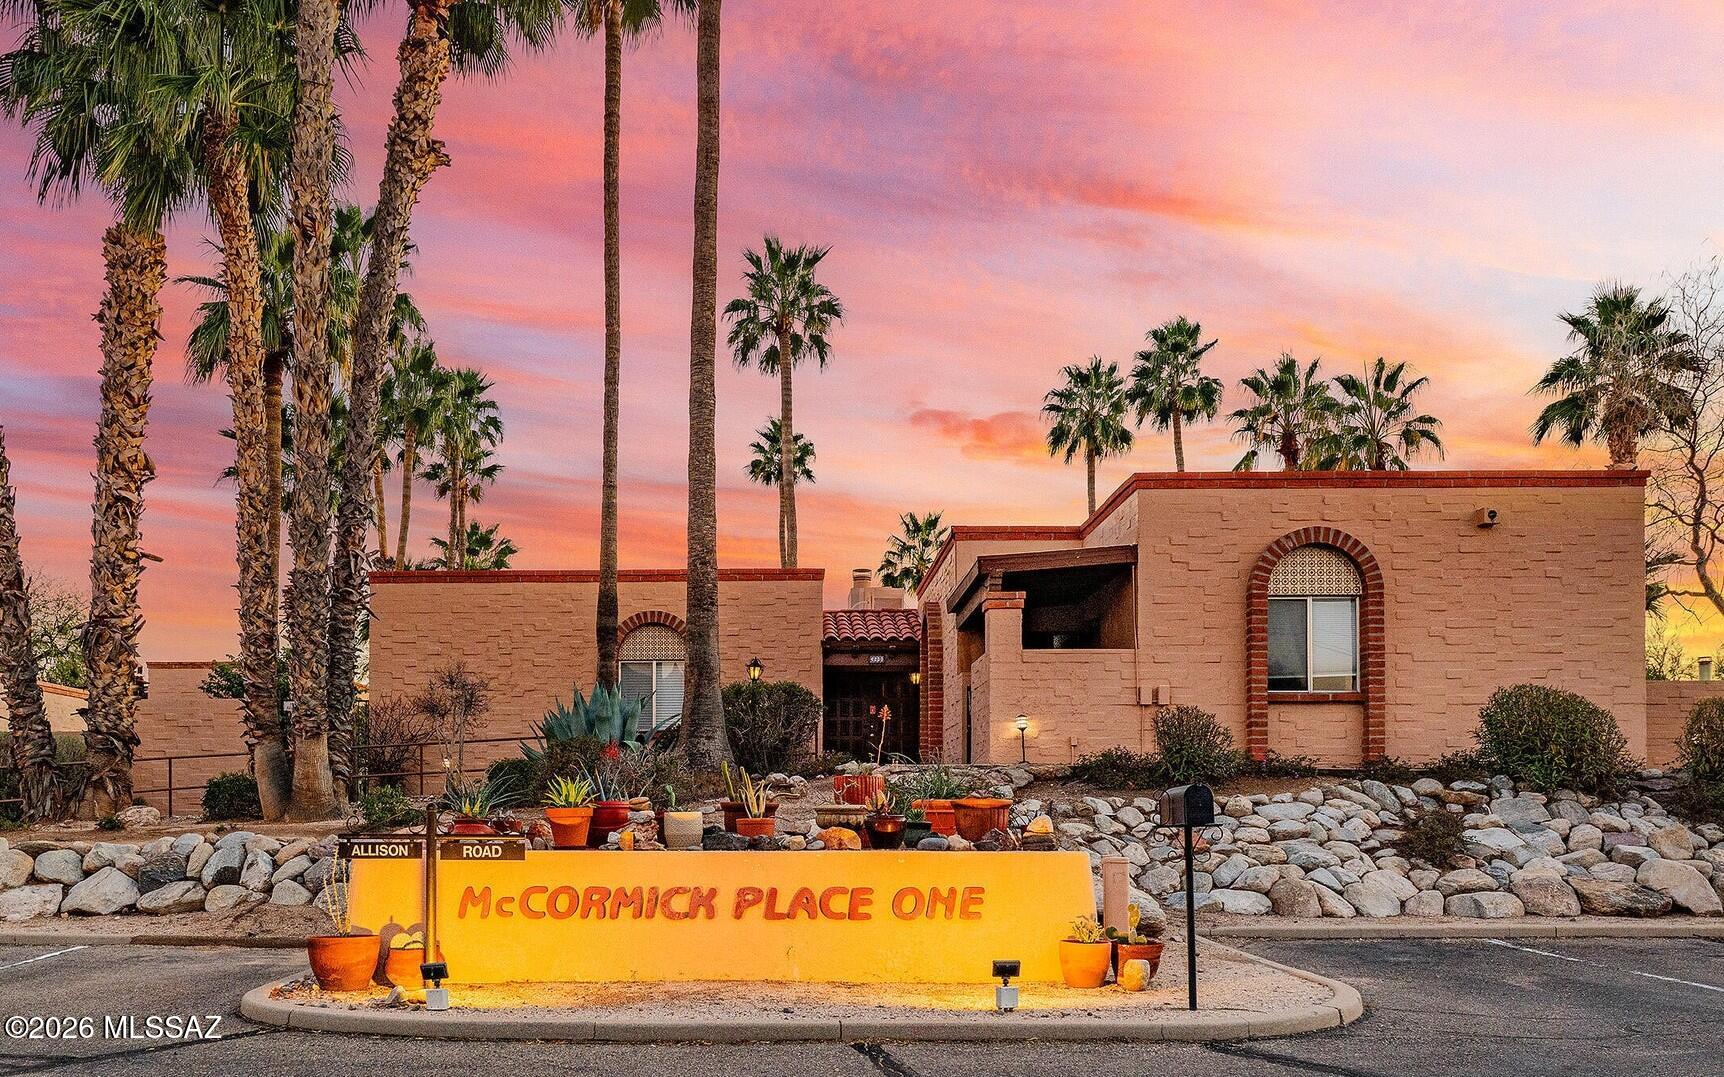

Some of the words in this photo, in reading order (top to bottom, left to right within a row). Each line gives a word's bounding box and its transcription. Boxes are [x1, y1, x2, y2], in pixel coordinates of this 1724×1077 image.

[351, 845, 408, 857] ALLISON
[462, 845, 502, 858] ROAD
[458, 885, 718, 920] McCORMICK
[733, 886, 874, 920] PLACE
[892, 886, 986, 920] ONE
